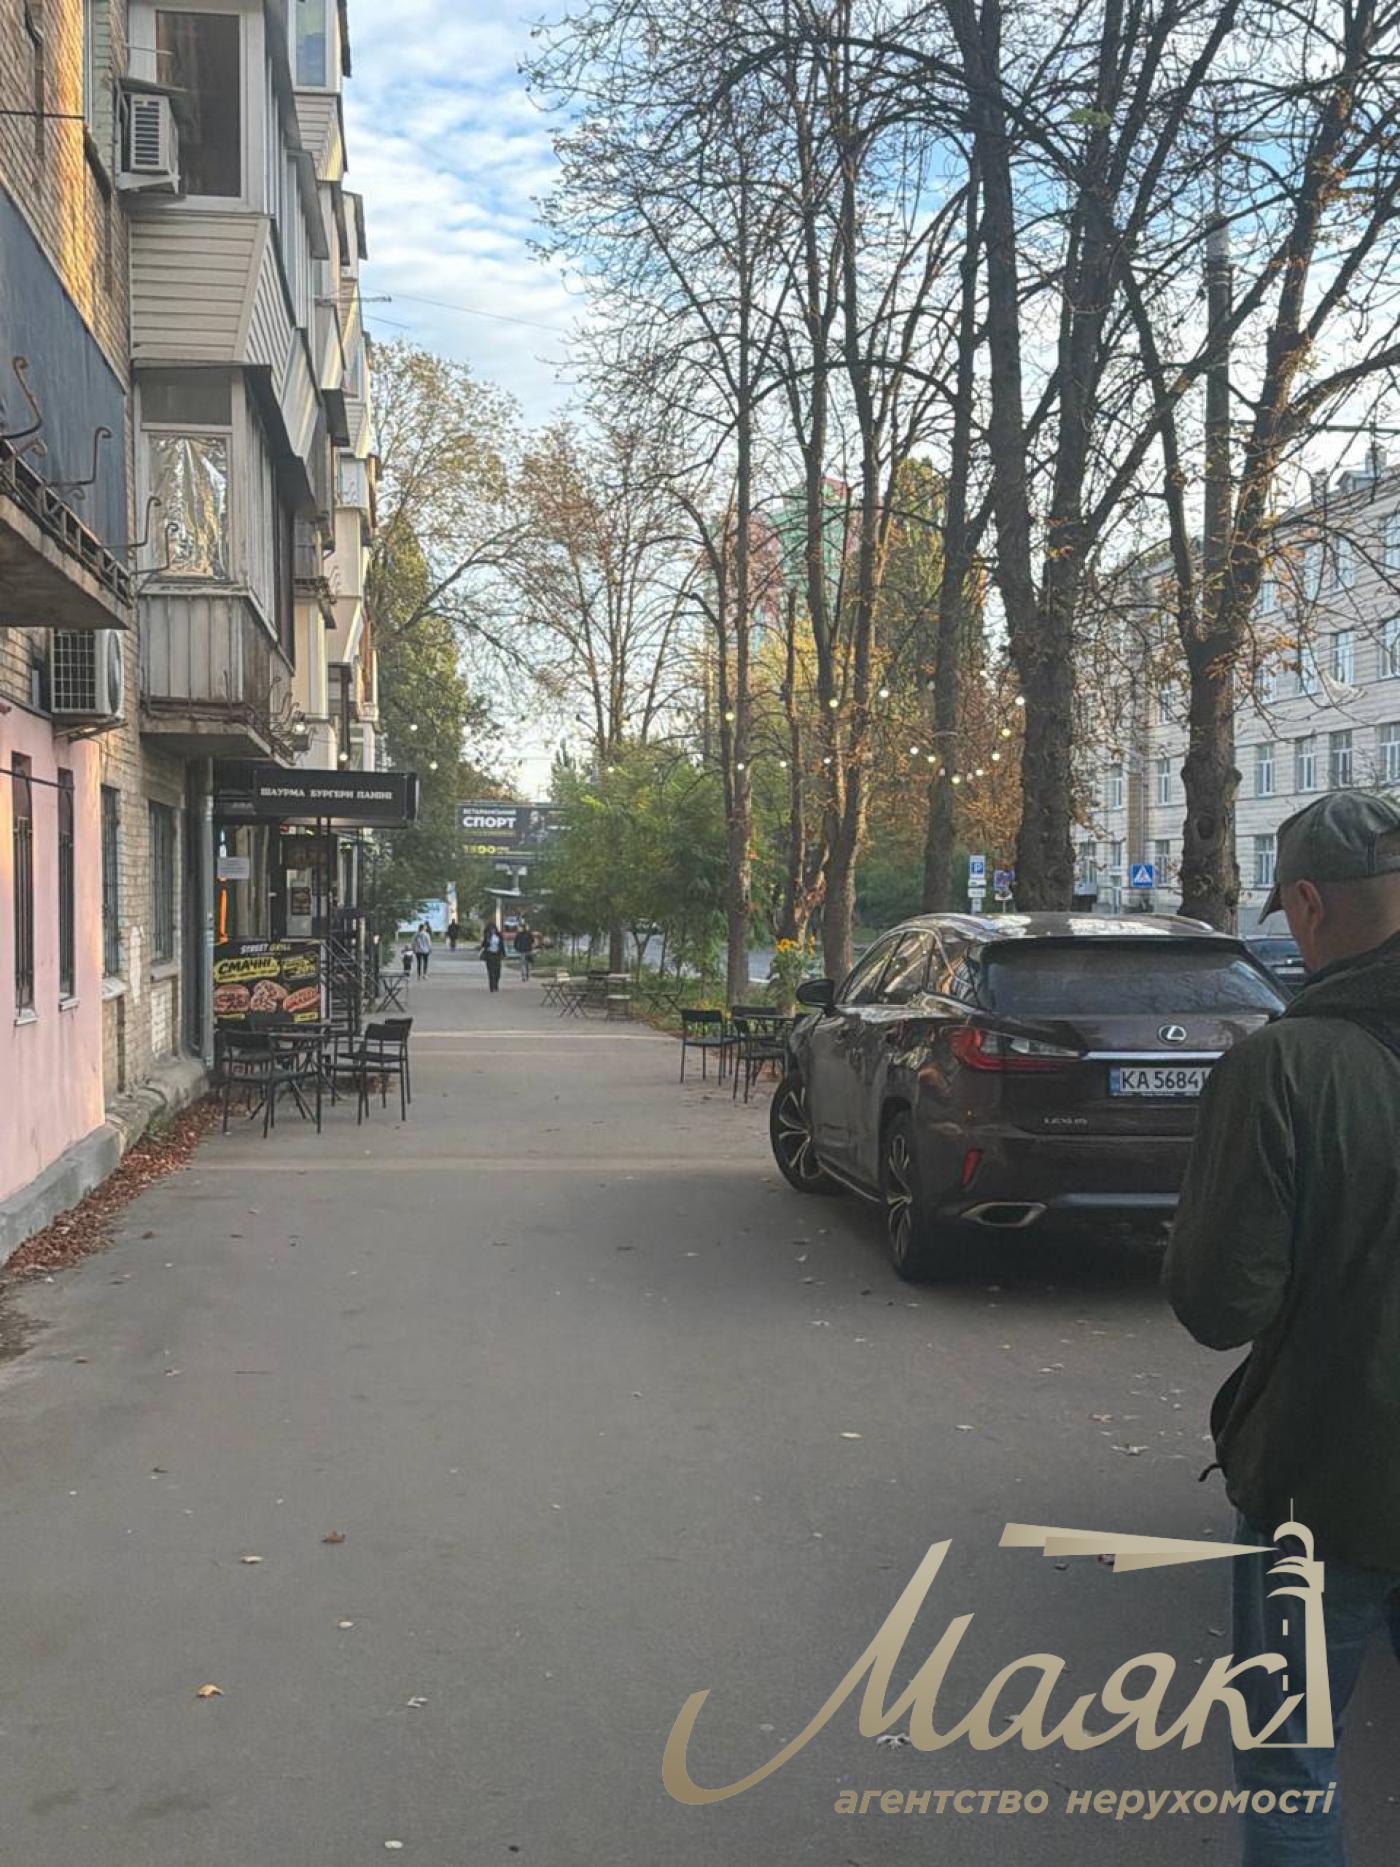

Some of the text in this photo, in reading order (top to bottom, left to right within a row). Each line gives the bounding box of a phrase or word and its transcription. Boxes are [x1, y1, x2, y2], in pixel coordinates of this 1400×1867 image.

[260, 787, 305, 797] ШАУРМА
[310, 789, 354, 799] БУРГЕРИ
[463, 816, 516, 828] СПОРТ
[218, 957, 272, 975] СМАЧНІ
